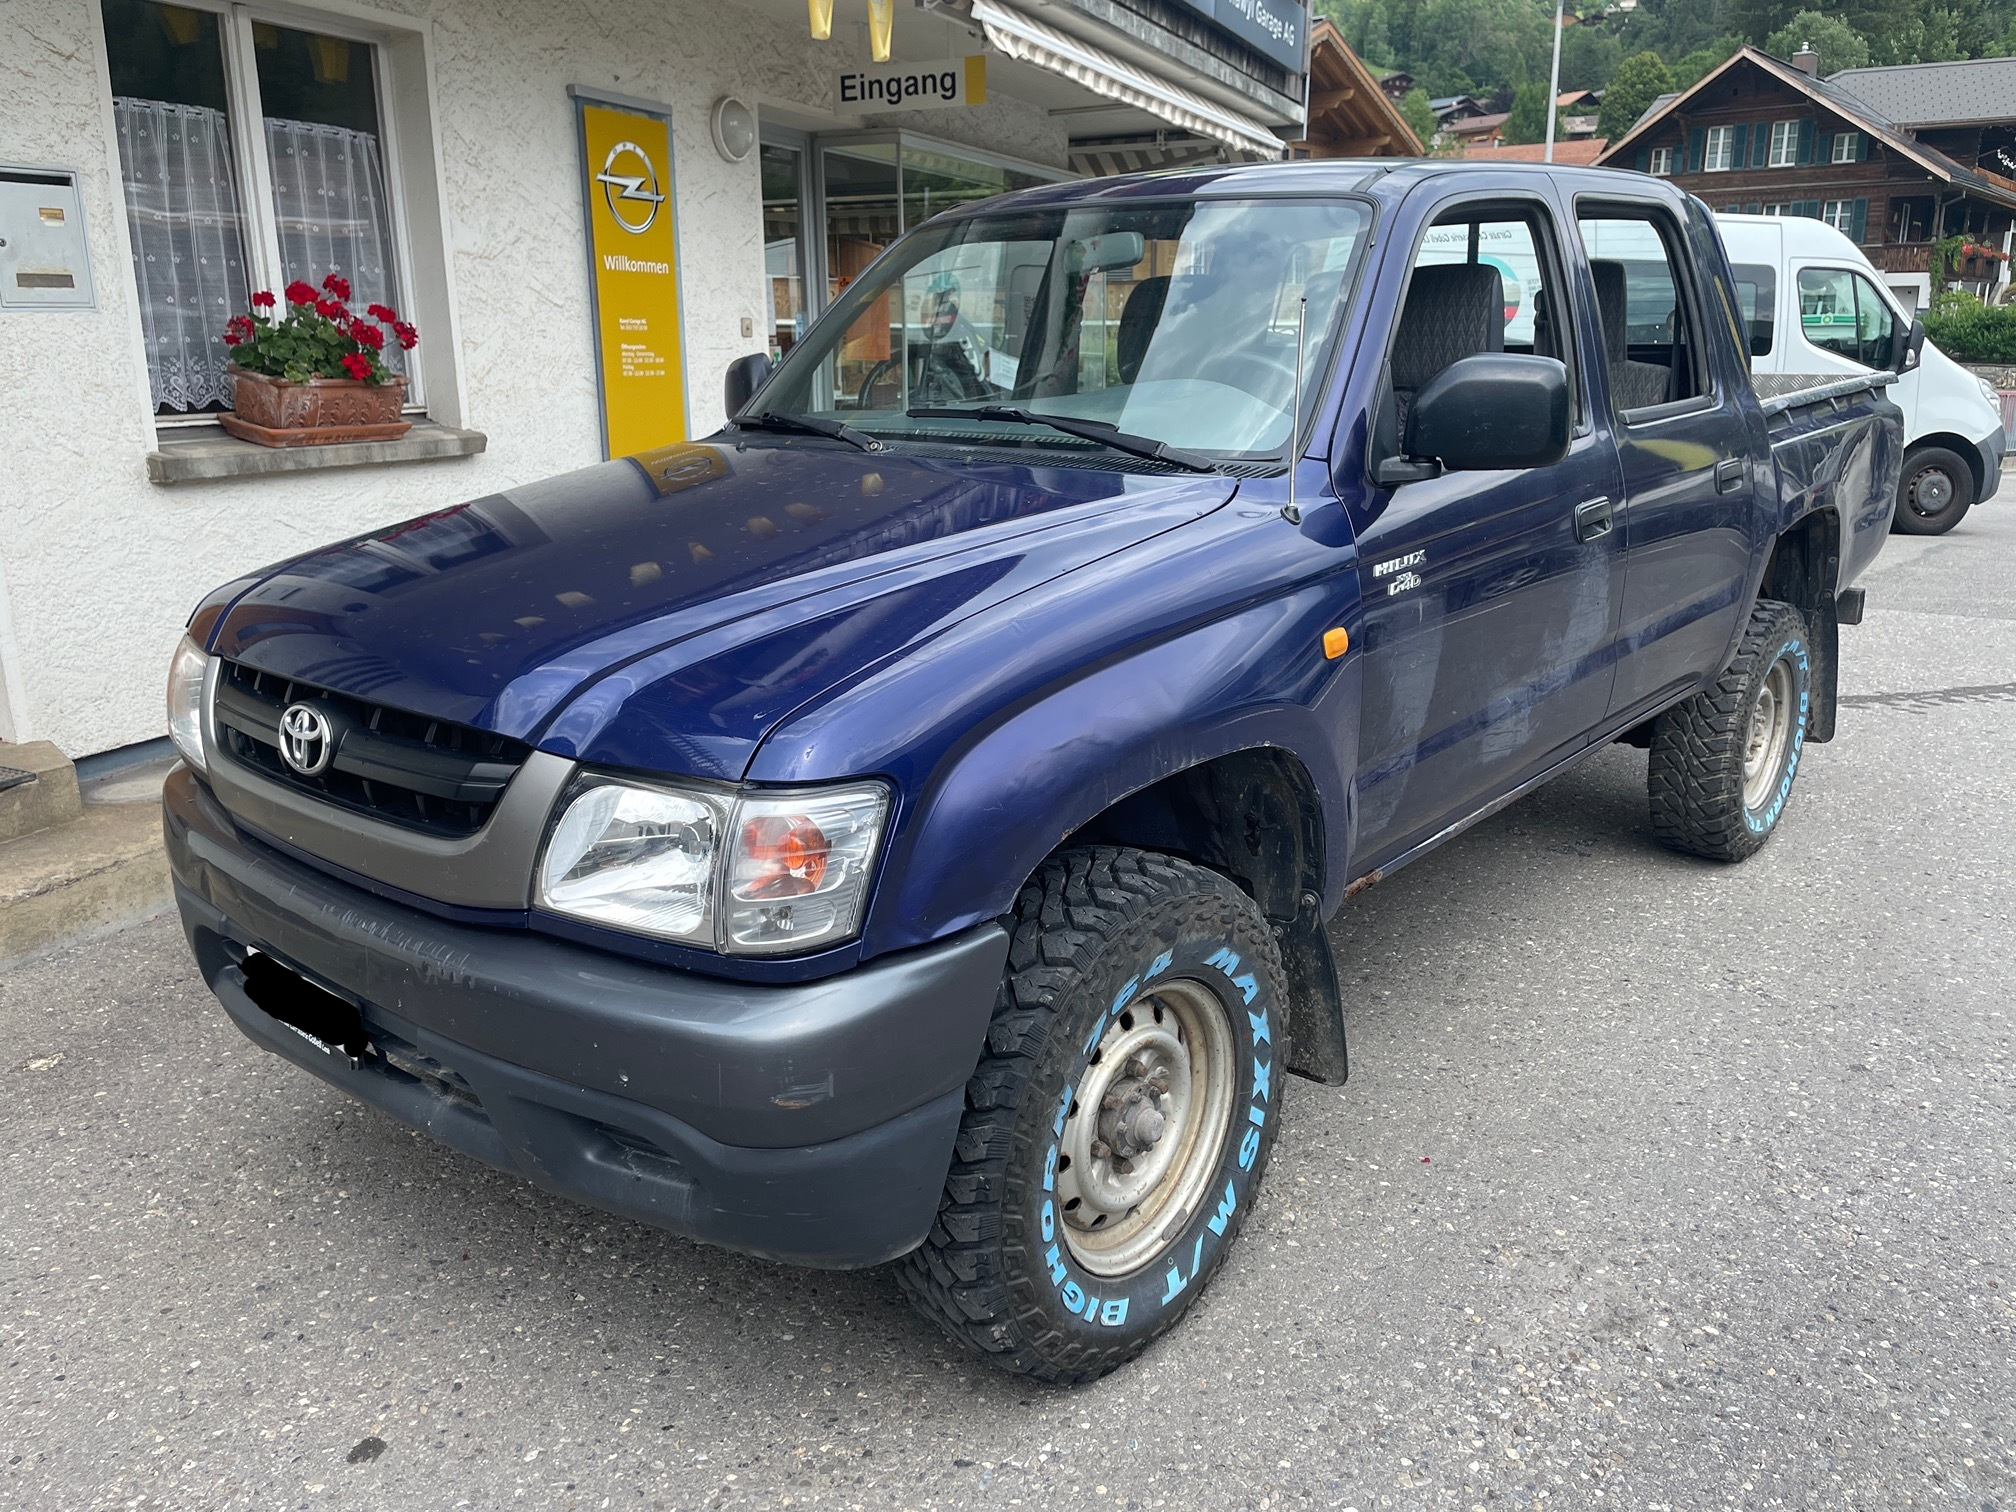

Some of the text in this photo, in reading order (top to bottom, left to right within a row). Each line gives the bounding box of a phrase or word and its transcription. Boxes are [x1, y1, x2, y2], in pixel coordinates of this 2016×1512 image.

[1255, 0, 1283, 39] Garage
[1283, 21, 1295, 47] AG
[840, 71, 956, 105] Eingang
[603, 255, 669, 274] Willkommen
[1373, 549, 1427, 577] HILUX
[1787, 639, 1809, 671] M/T
[1765, 692, 1809, 827] BIGHORN
[1203, 946, 1272, 1174] MAXXIS
[1040, 1084, 1130, 1327] BIGHORN
[1161, 1179, 1237, 1306] M/T
